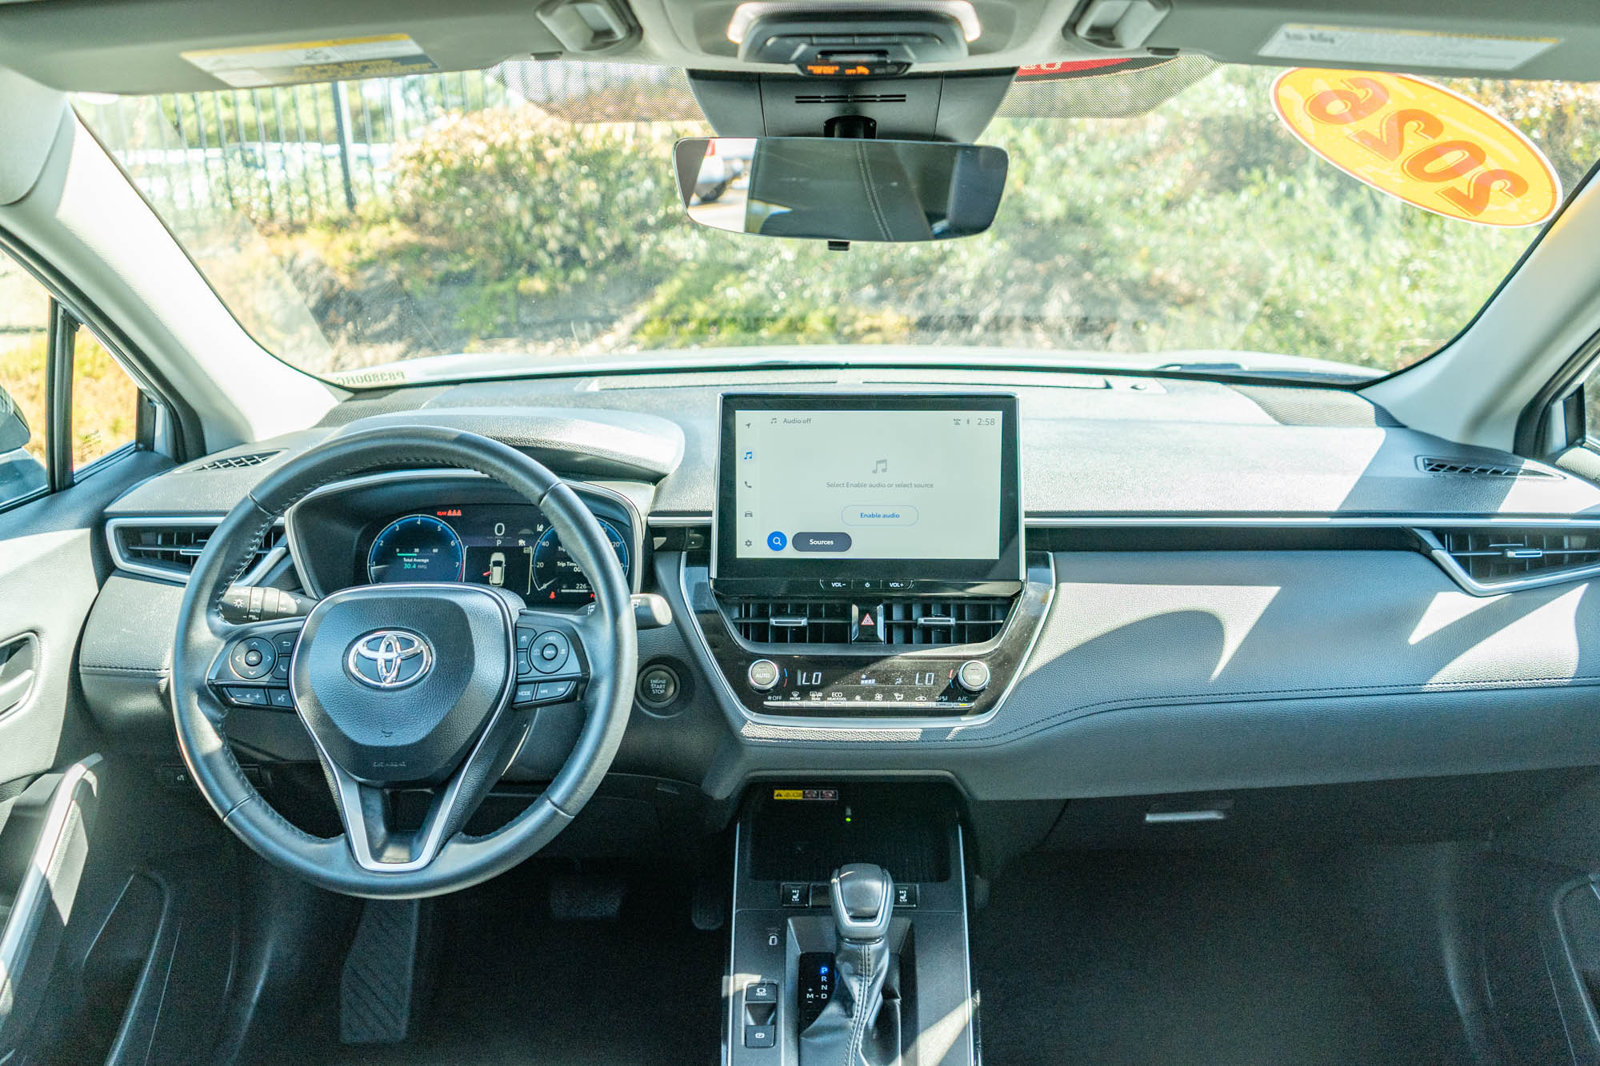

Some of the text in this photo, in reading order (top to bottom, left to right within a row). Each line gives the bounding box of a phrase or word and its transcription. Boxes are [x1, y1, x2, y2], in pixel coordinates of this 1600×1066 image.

[783, 417, 812, 425] Audio off
[977, 418, 996, 426] 2:58
[826, 481, 845, 489] Select
[846, 481, 868, 489] Enable
[868, 481, 886, 489] audio
[895, 481, 912, 489] select
[494, 522, 506, 536] 0
[802, 672, 822, 685] LO
[914, 672, 935, 686] LO
